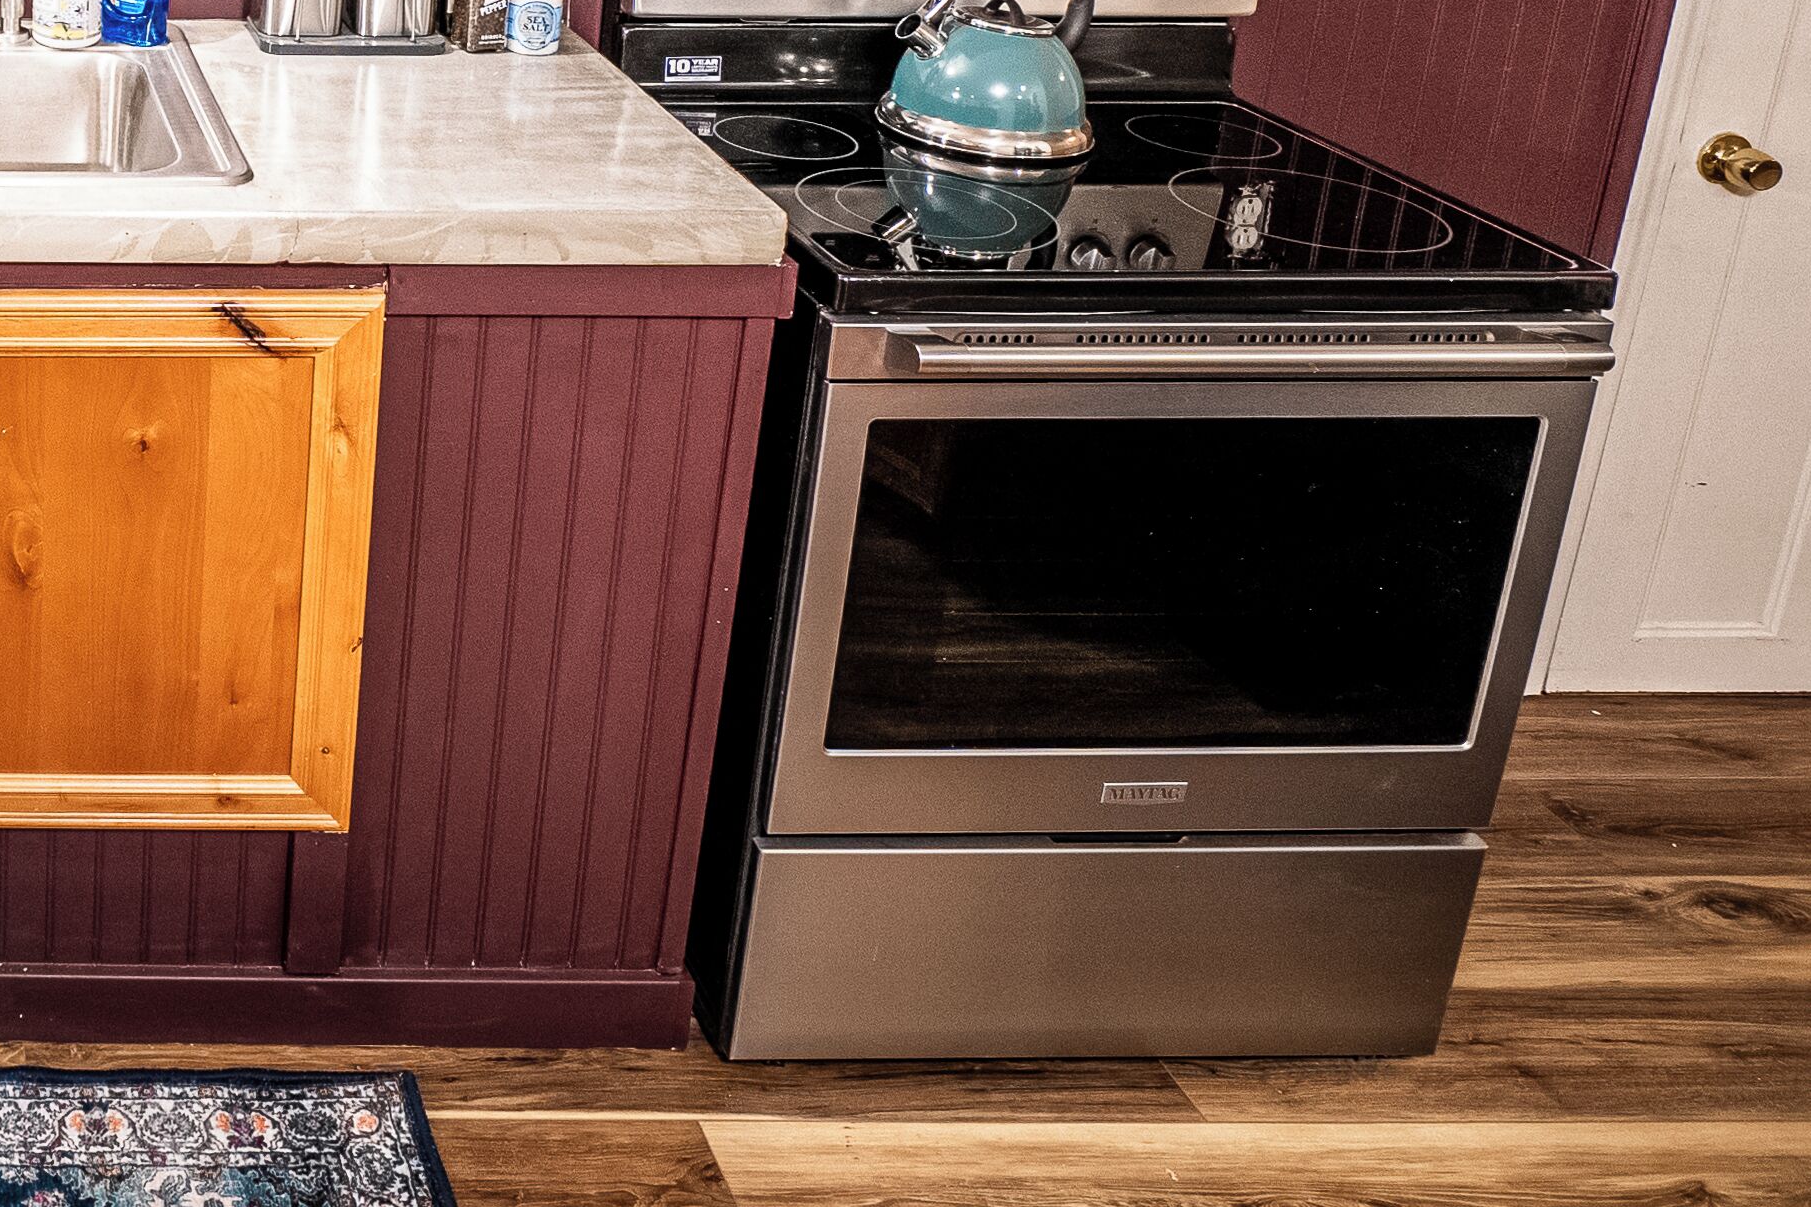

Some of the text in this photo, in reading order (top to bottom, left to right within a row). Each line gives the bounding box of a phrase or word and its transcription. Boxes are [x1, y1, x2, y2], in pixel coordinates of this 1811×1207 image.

[480, 0, 508, 17] PEPPER
[526, 15, 547, 24] SEA
[522, 23, 550, 32] SALT
[669, 58, 719, 74] 10 YEAR
[1108, 787, 1180, 800] MAYTAG
